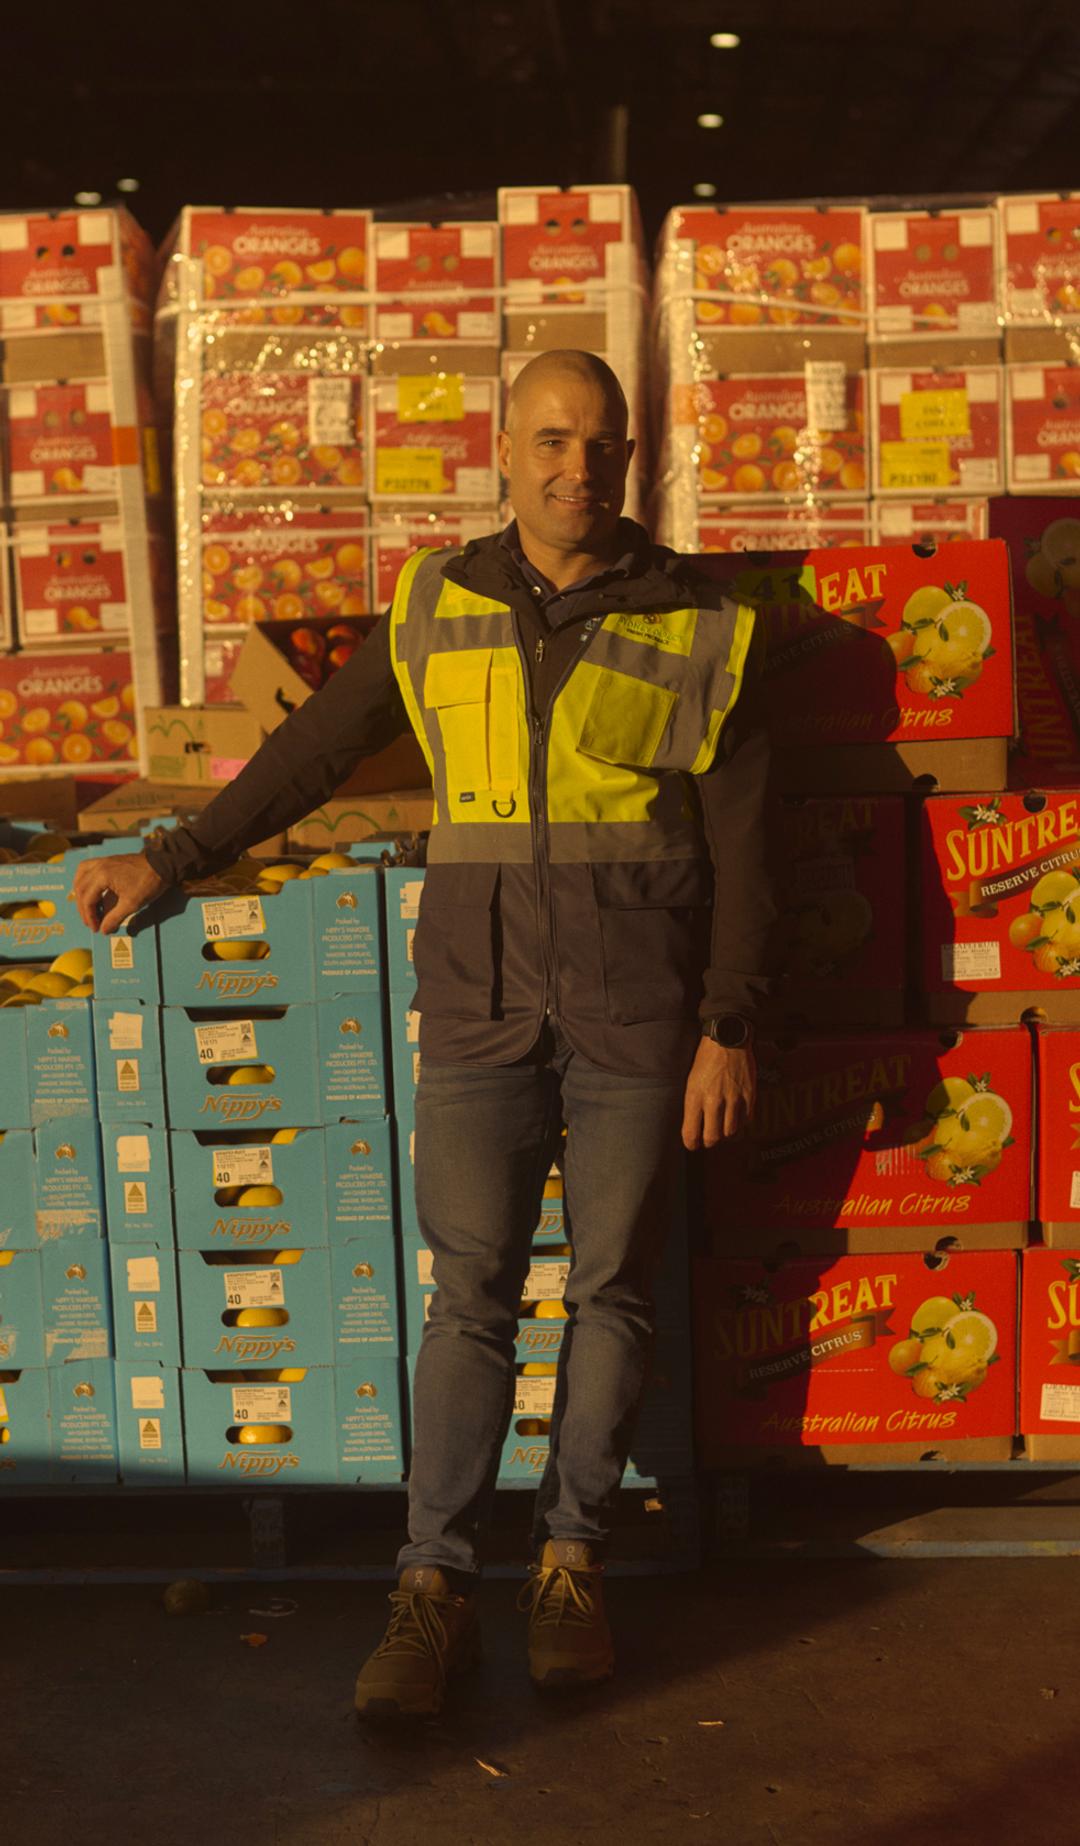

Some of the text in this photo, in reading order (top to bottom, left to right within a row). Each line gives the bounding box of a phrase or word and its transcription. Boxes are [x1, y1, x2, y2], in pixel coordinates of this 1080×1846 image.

[234, 236, 320, 257] ORANGES
[727, 234, 816, 254] ORANGES
[900, 279, 970, 298] ORANGES
[44, 583, 113, 603] ORANGES
[17, 675, 104, 698] ORANGES
[878, 704, 954, 731] Citrus
[980, 866, 1040, 897] RESERVE
[206, 924, 220, 936] 40
[195, 970, 280, 999] Nippy's
[200, 1048, 214, 1060] 40
[200, 1093, 281, 1124] Nippy's
[217, 1171, 231, 1183] 40
[770, 1191, 972, 1217] Australian Citrus
[209, 1217, 291, 1245] Nippy's
[228, 1294, 241, 1305] 40
[712, 1273, 898, 1361] SUNTREAT
[214, 1334, 296, 1363] Nippy's
[749, 1328, 863, 1380] RESERVE CITRUS
[234, 1409, 248, 1419] 40
[762, 1408, 957, 1434] Australian Citrus
[218, 1450, 301, 1479] Nippy's
